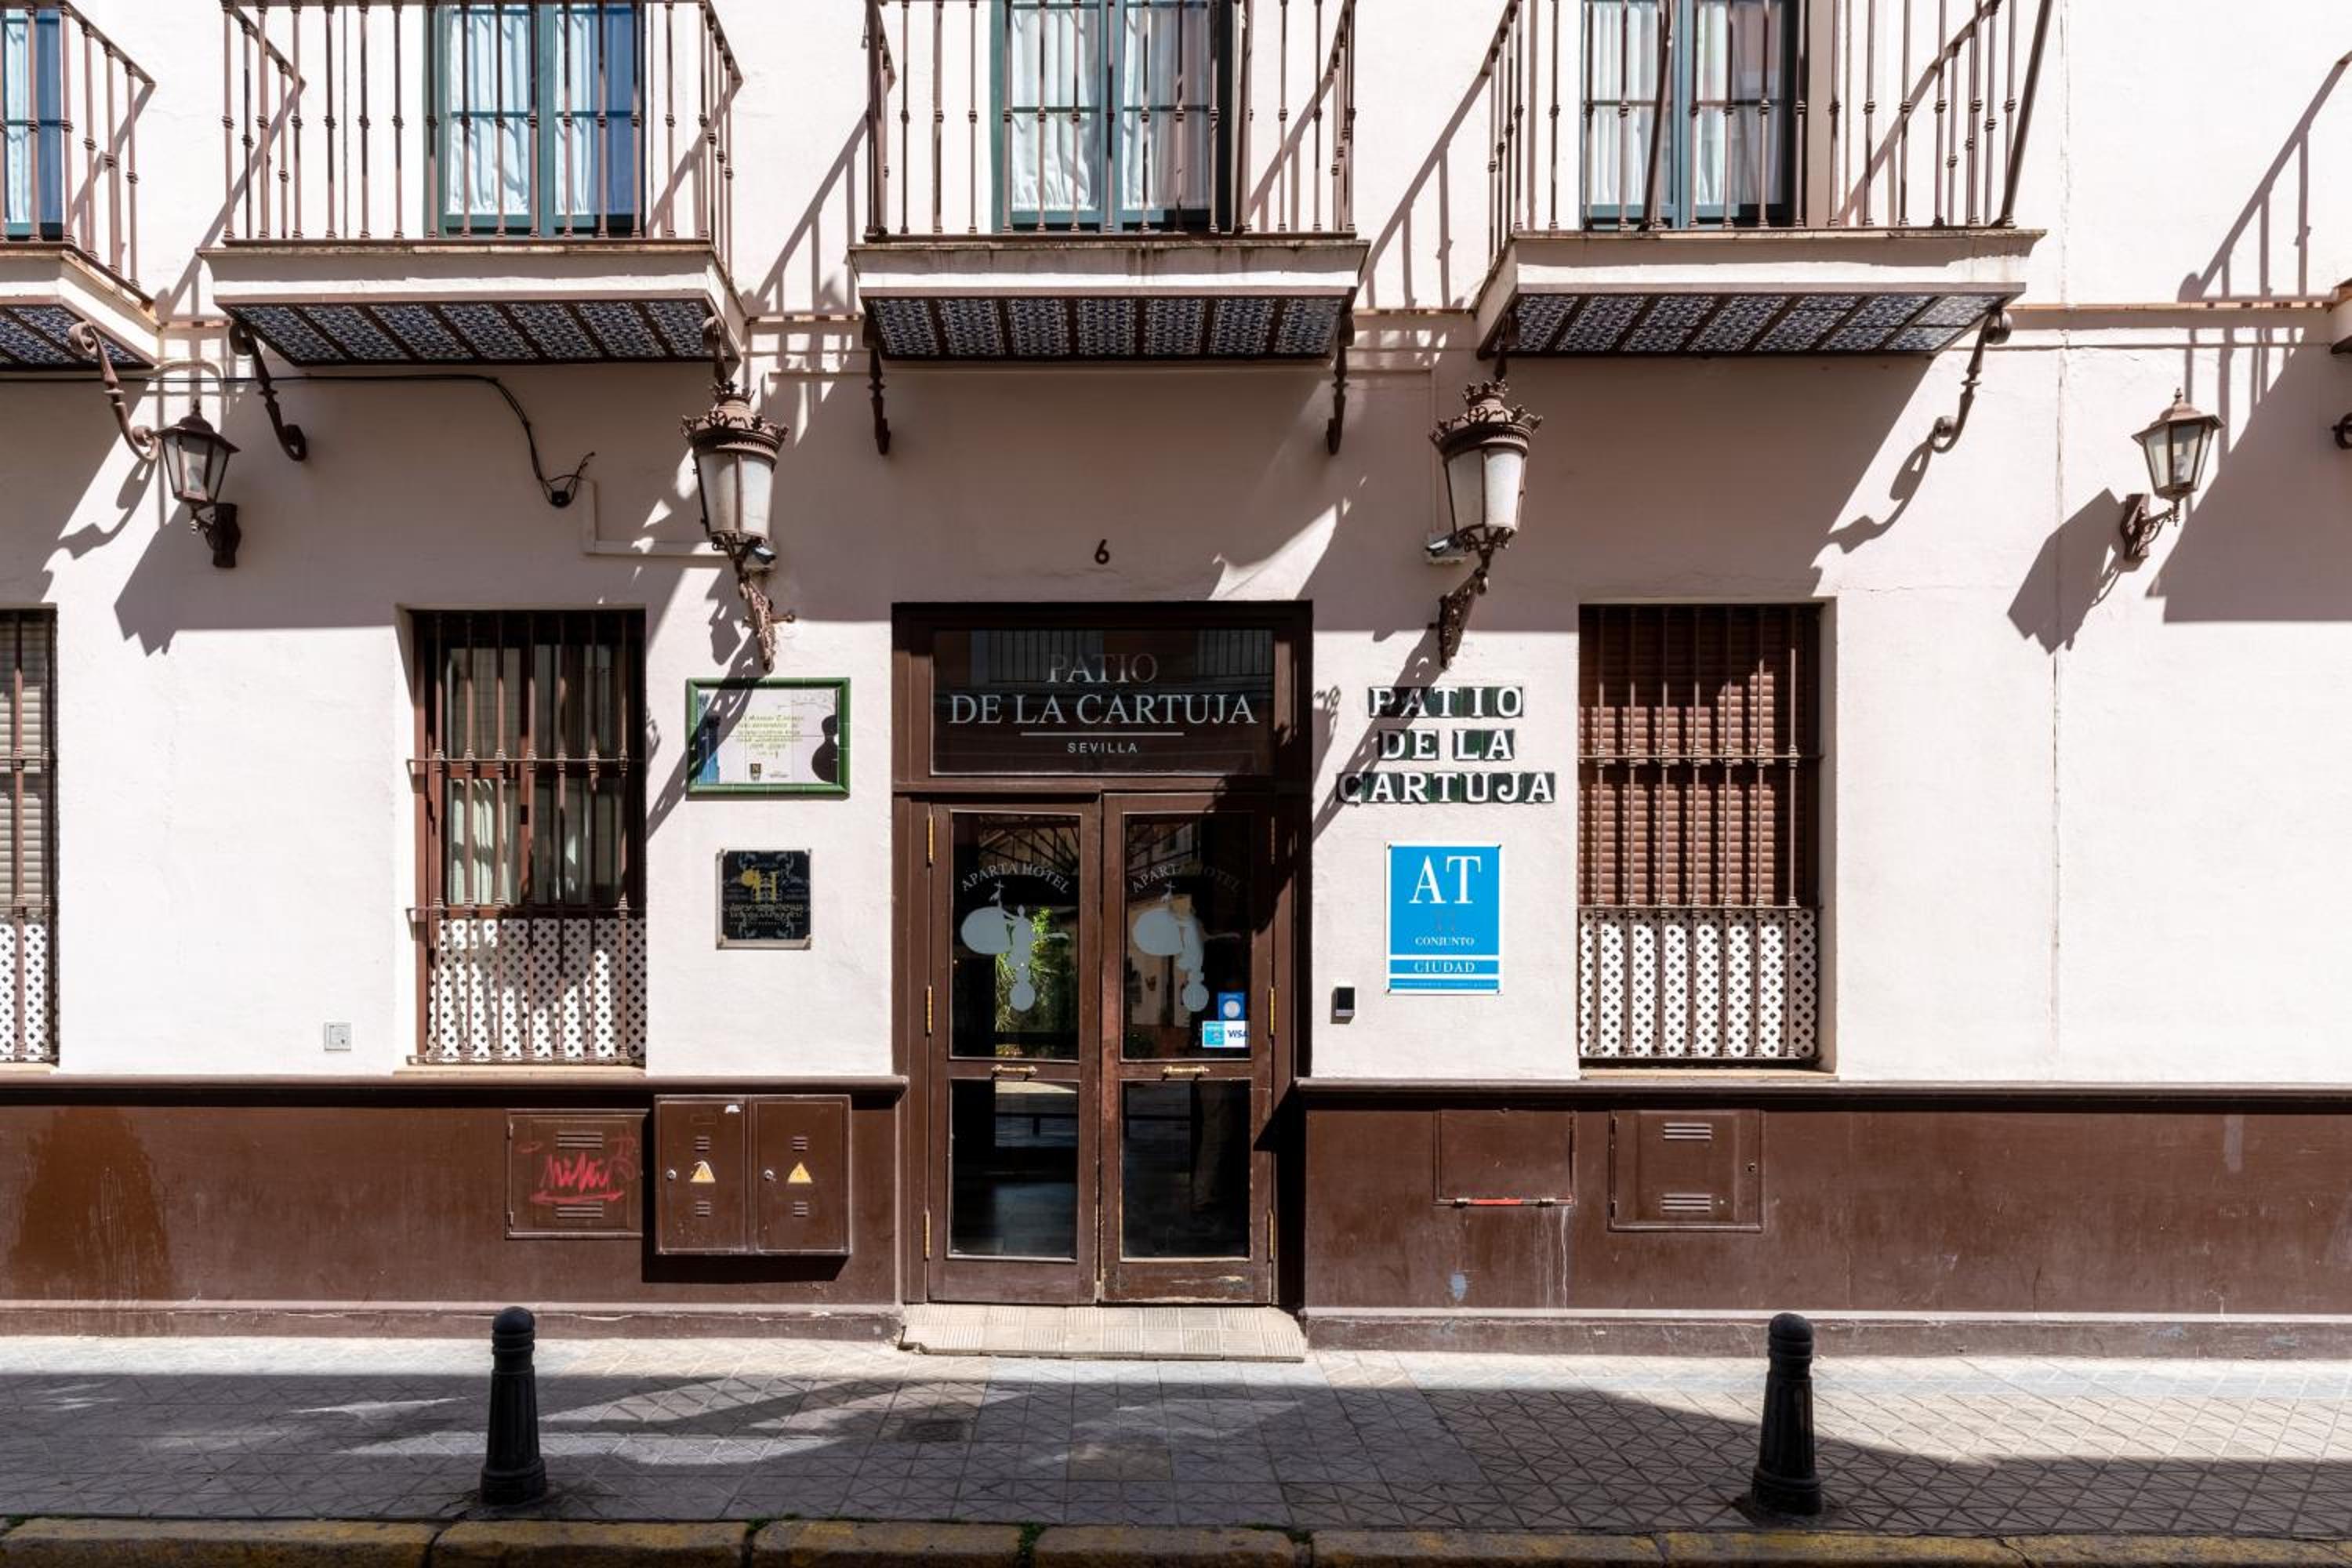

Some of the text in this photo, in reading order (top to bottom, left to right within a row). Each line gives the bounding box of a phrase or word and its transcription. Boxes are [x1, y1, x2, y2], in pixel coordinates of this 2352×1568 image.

[1094, 539, 1110, 564] 6
[1046, 653, 1159, 684] PATIO
[947, 694, 1259, 724] DE LA CARTUJA
[1370, 686, 1523, 718] PATIO
[1067, 742, 1138, 754] SEVILLA
[1380, 728, 1514, 760] DE LA
[1337, 771, 1555, 804] CARTUJA
[961, 862, 1070, 895] APARTA HOTEL
[1409, 855, 1482, 904] AT
[1414, 936, 1475, 947] CONJUNTO
[1414, 961, 1475, 974] CIUDAD
[1226, 1029, 1249, 1039] VISA
